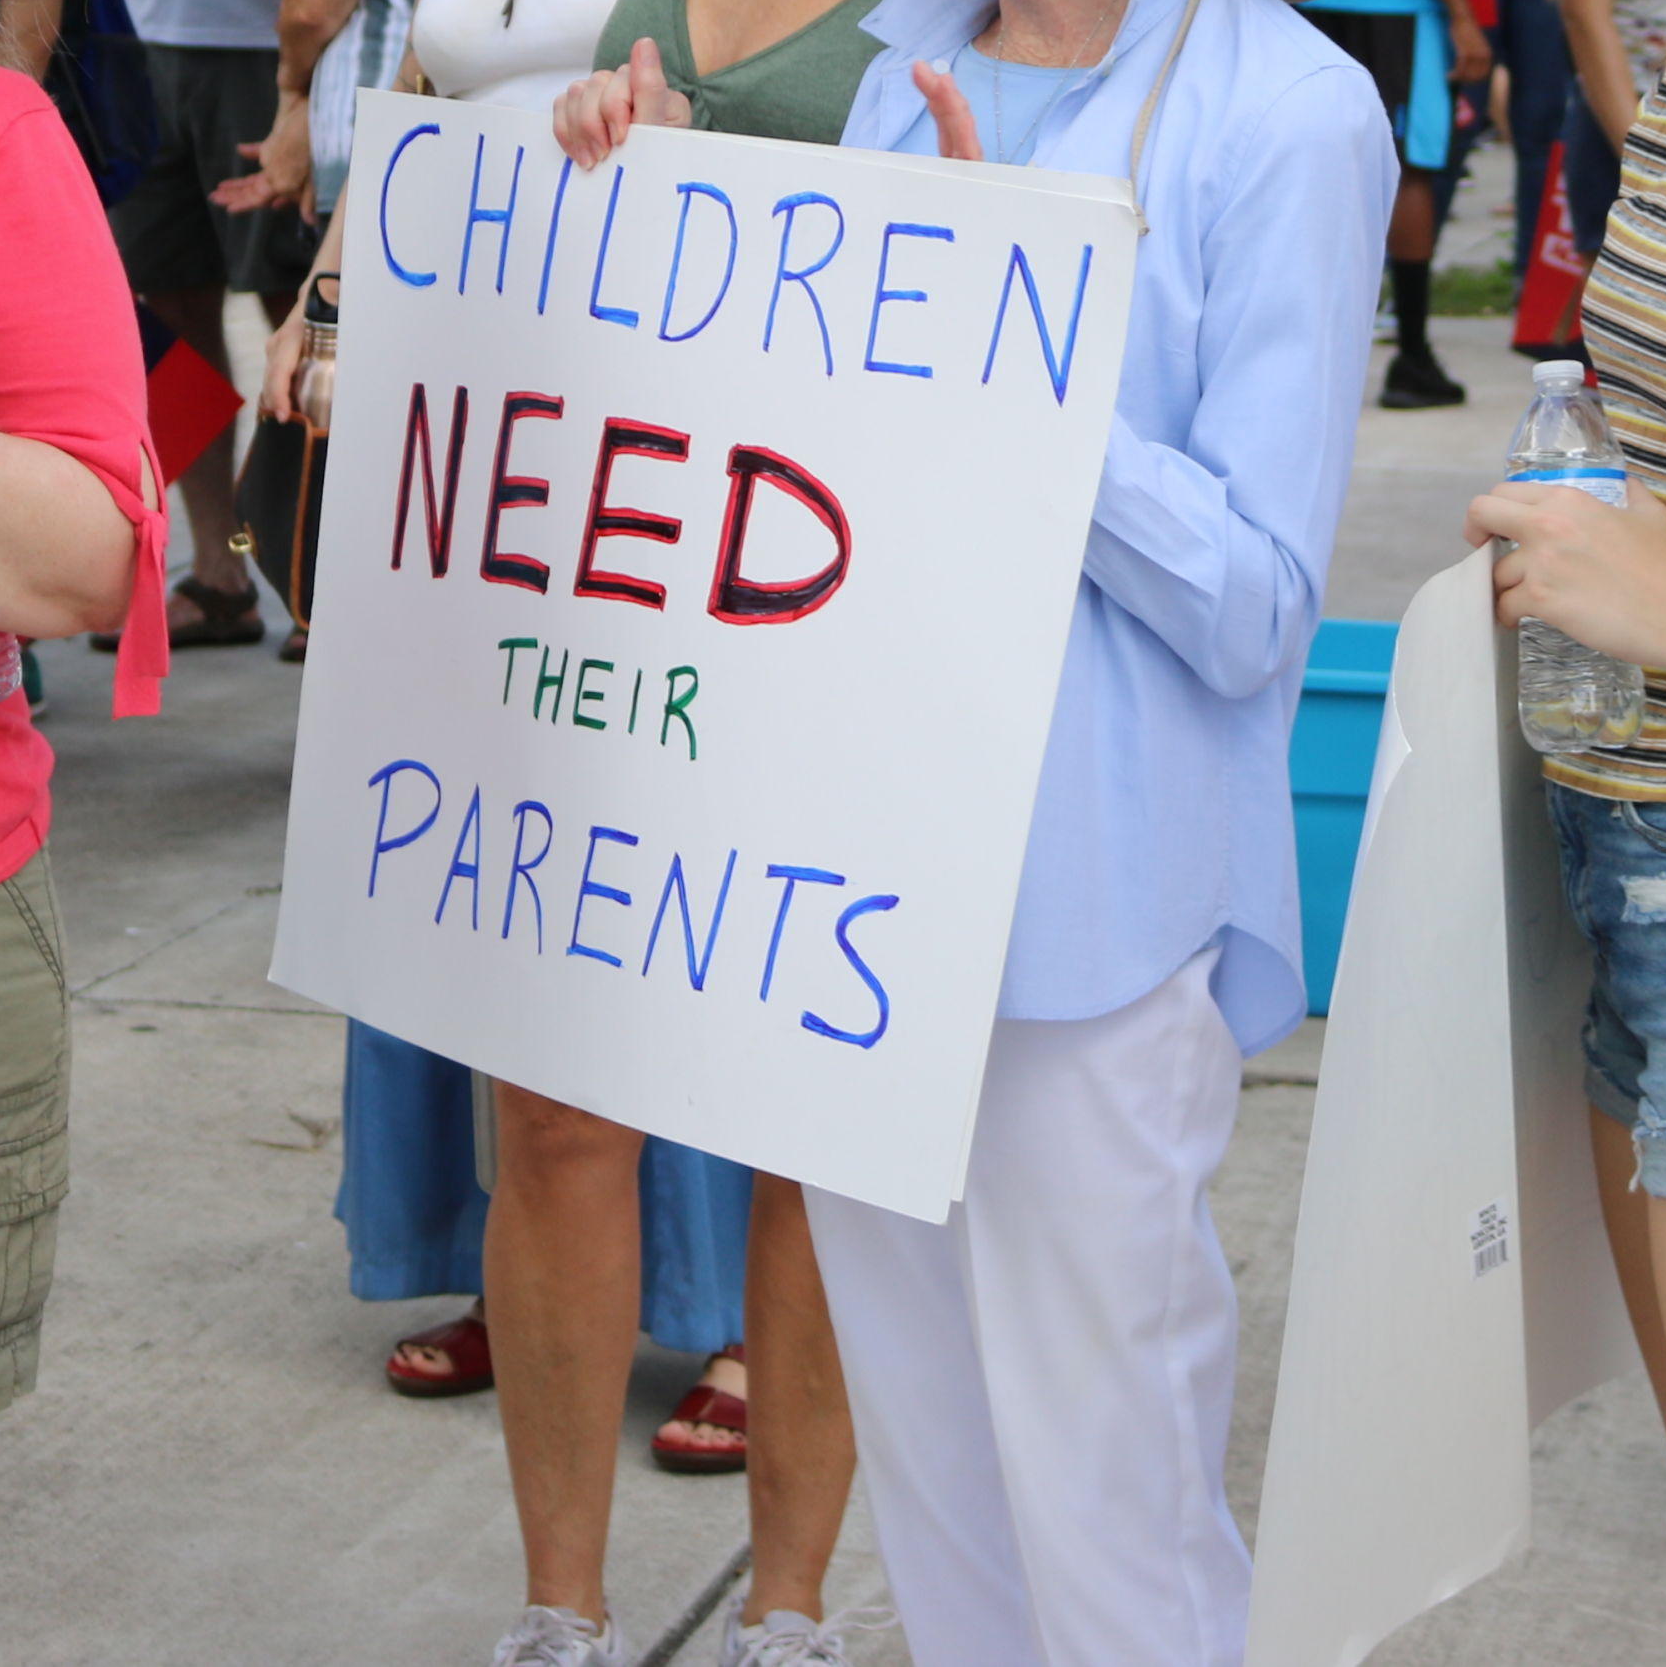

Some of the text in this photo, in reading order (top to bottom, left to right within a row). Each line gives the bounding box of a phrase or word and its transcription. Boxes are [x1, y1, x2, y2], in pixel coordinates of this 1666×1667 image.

[379, 122, 1093, 407] CHILDREN
[391, 382, 853, 625] NEED
[498, 637, 699, 760] THEIR
[368, 759, 900, 1049] PARENTS
